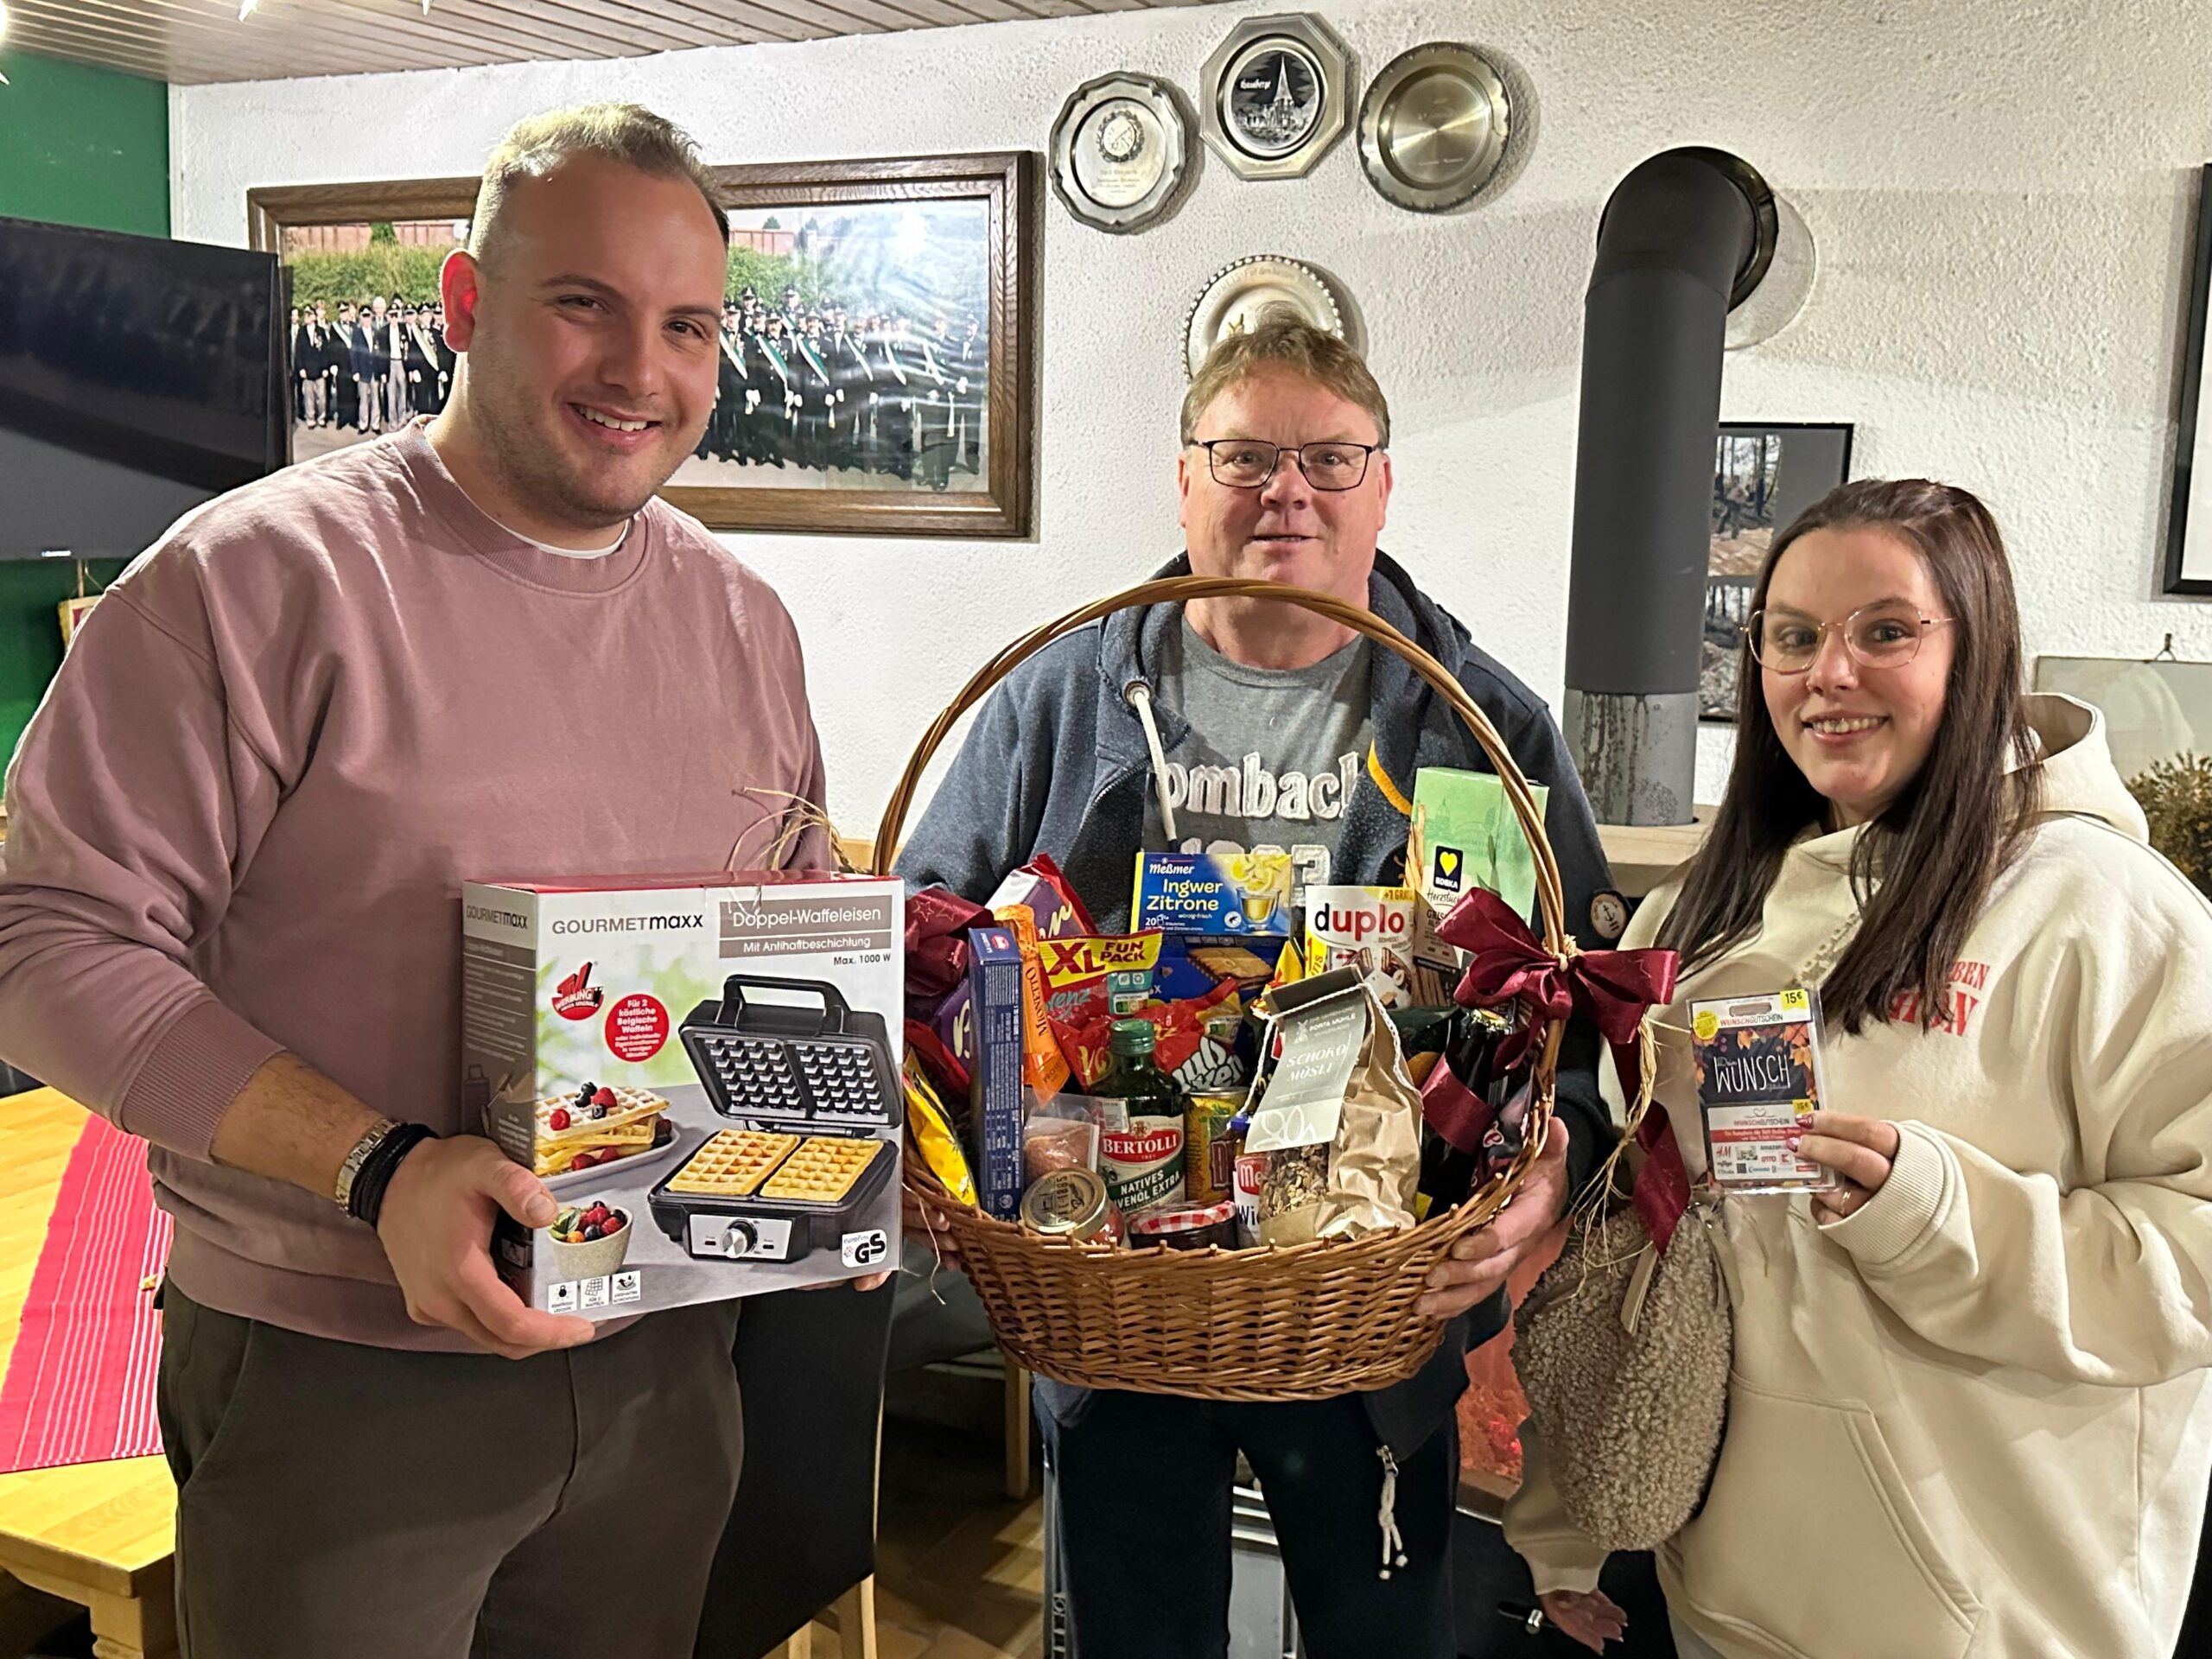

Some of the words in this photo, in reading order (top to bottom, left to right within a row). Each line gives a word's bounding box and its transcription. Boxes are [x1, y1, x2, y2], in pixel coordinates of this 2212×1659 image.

[1149, 864, 1195, 874] Meßmer
[1163, 879, 1224, 897] Ingwer
[1434, 877, 1459, 889] EDEKA
[1147, 895, 1219, 911] Zitrone
[466, 905, 528, 930] GOURMETmaxx
[552, 913, 703, 934] GOURMETmaxx
[733, 907, 881, 929] Doppel-Waffeleisen
[1145, 918, 1157, 926] 20
[1315, 903, 1405, 942] duplo
[744, 941, 760, 953] Mit
[763, 937, 871, 952] Antihaftbeschichtung
[1104, 940, 1145, 953] FUN
[833, 956, 856, 966] Max.
[860, 955, 880, 963] 1000
[883, 953, 892, 962] W
[1047, 942, 1106, 976] XL
[1100, 950, 1147, 963] PACK
[627, 999, 640, 1008] Für
[642, 999, 648, 1007] 2
[1025, 966, 1050, 1037] MIONETTO
[1785, 992, 1802, 1004] 15€
[617, 1016, 658, 1027] Belgische
[619, 1007, 656, 1017] köstliche
[1287, 1044, 1347, 1068] SCHOKO
[1287, 1062, 1333, 1082] MÜSLI
[1713, 1054, 1791, 1093] WUNSCH
[1103, 1134, 1177, 1154] BERTOLLI
[1121, 1170, 1164, 1196] NATIVES
[1153, 1171, 1180, 1193] EXTRA
[855, 1233, 886, 1263] GS
